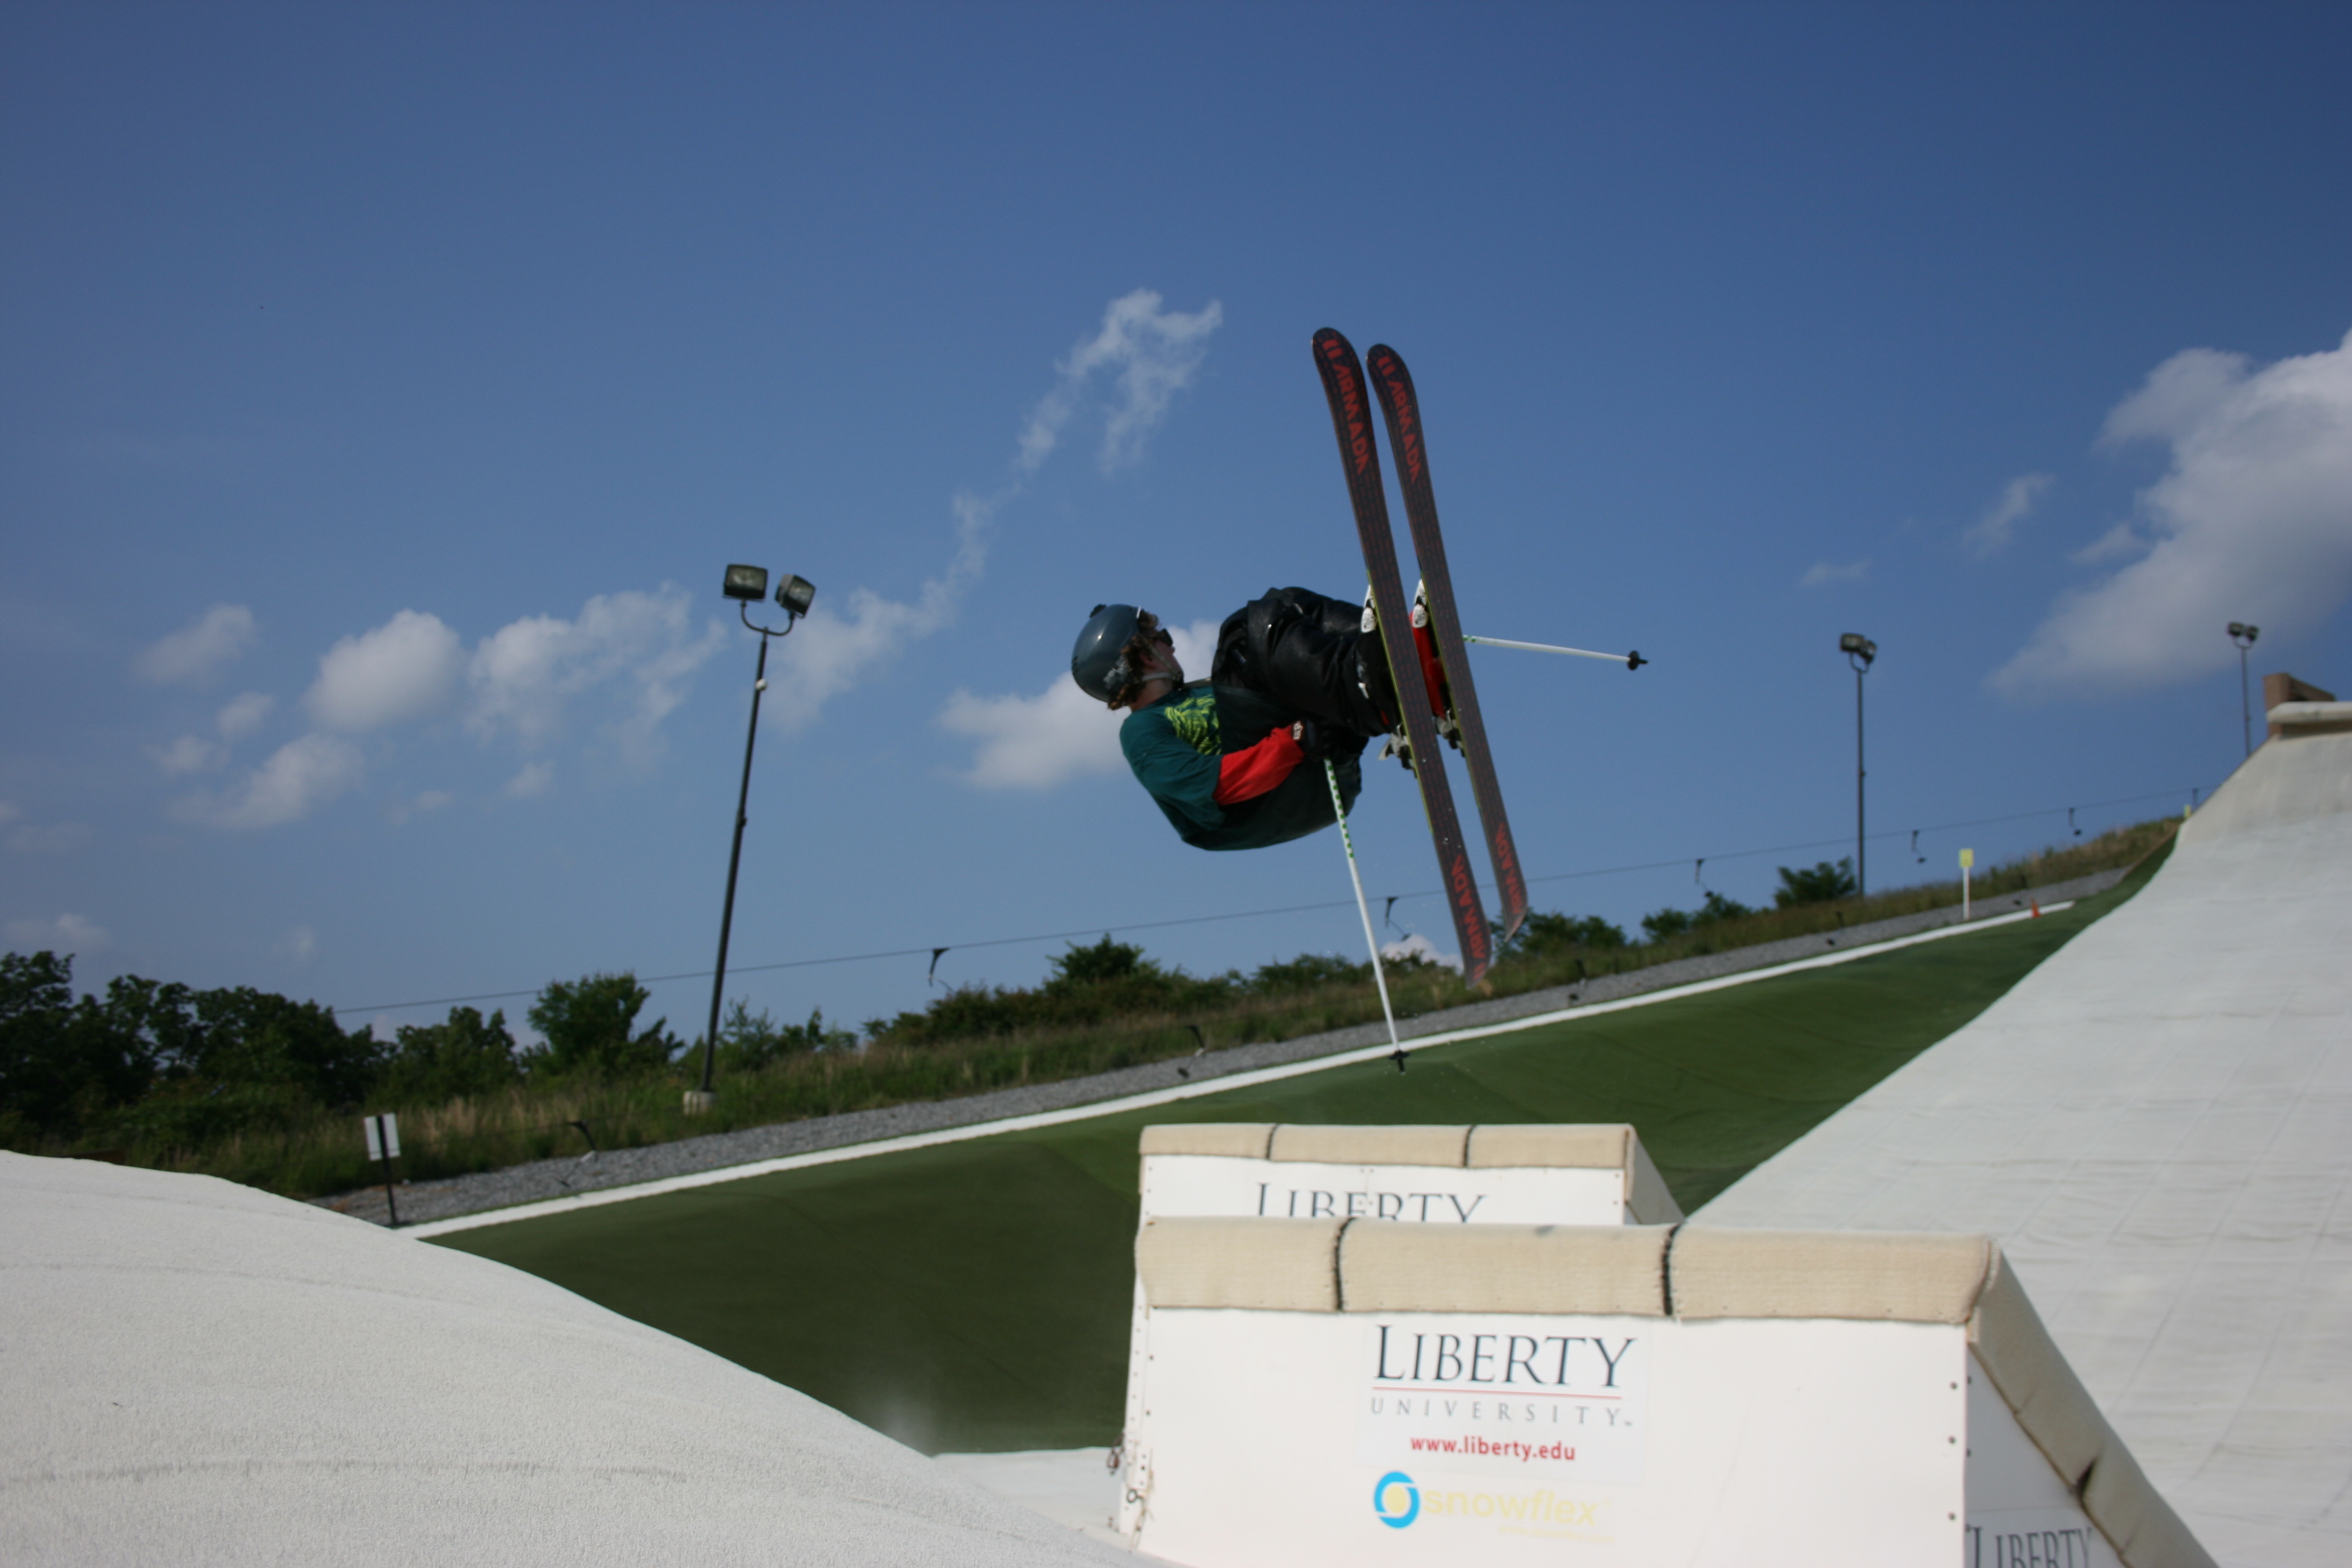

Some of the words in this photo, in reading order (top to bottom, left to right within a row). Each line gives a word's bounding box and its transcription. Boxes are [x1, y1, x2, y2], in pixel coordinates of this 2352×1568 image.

[1333, 364, 1370, 474] ARMADA
[1388, 381, 1422, 484] ARMADA
[1452, 854, 1486, 959] ARMADA
[1374, 1324, 1638, 1388] LIBERTY
[1370, 1397, 1622, 1426] UNIVERSITY
[1410, 1436, 1576, 1462] www.liberty.edu
[1423, 1489, 1599, 1526] snowflex
